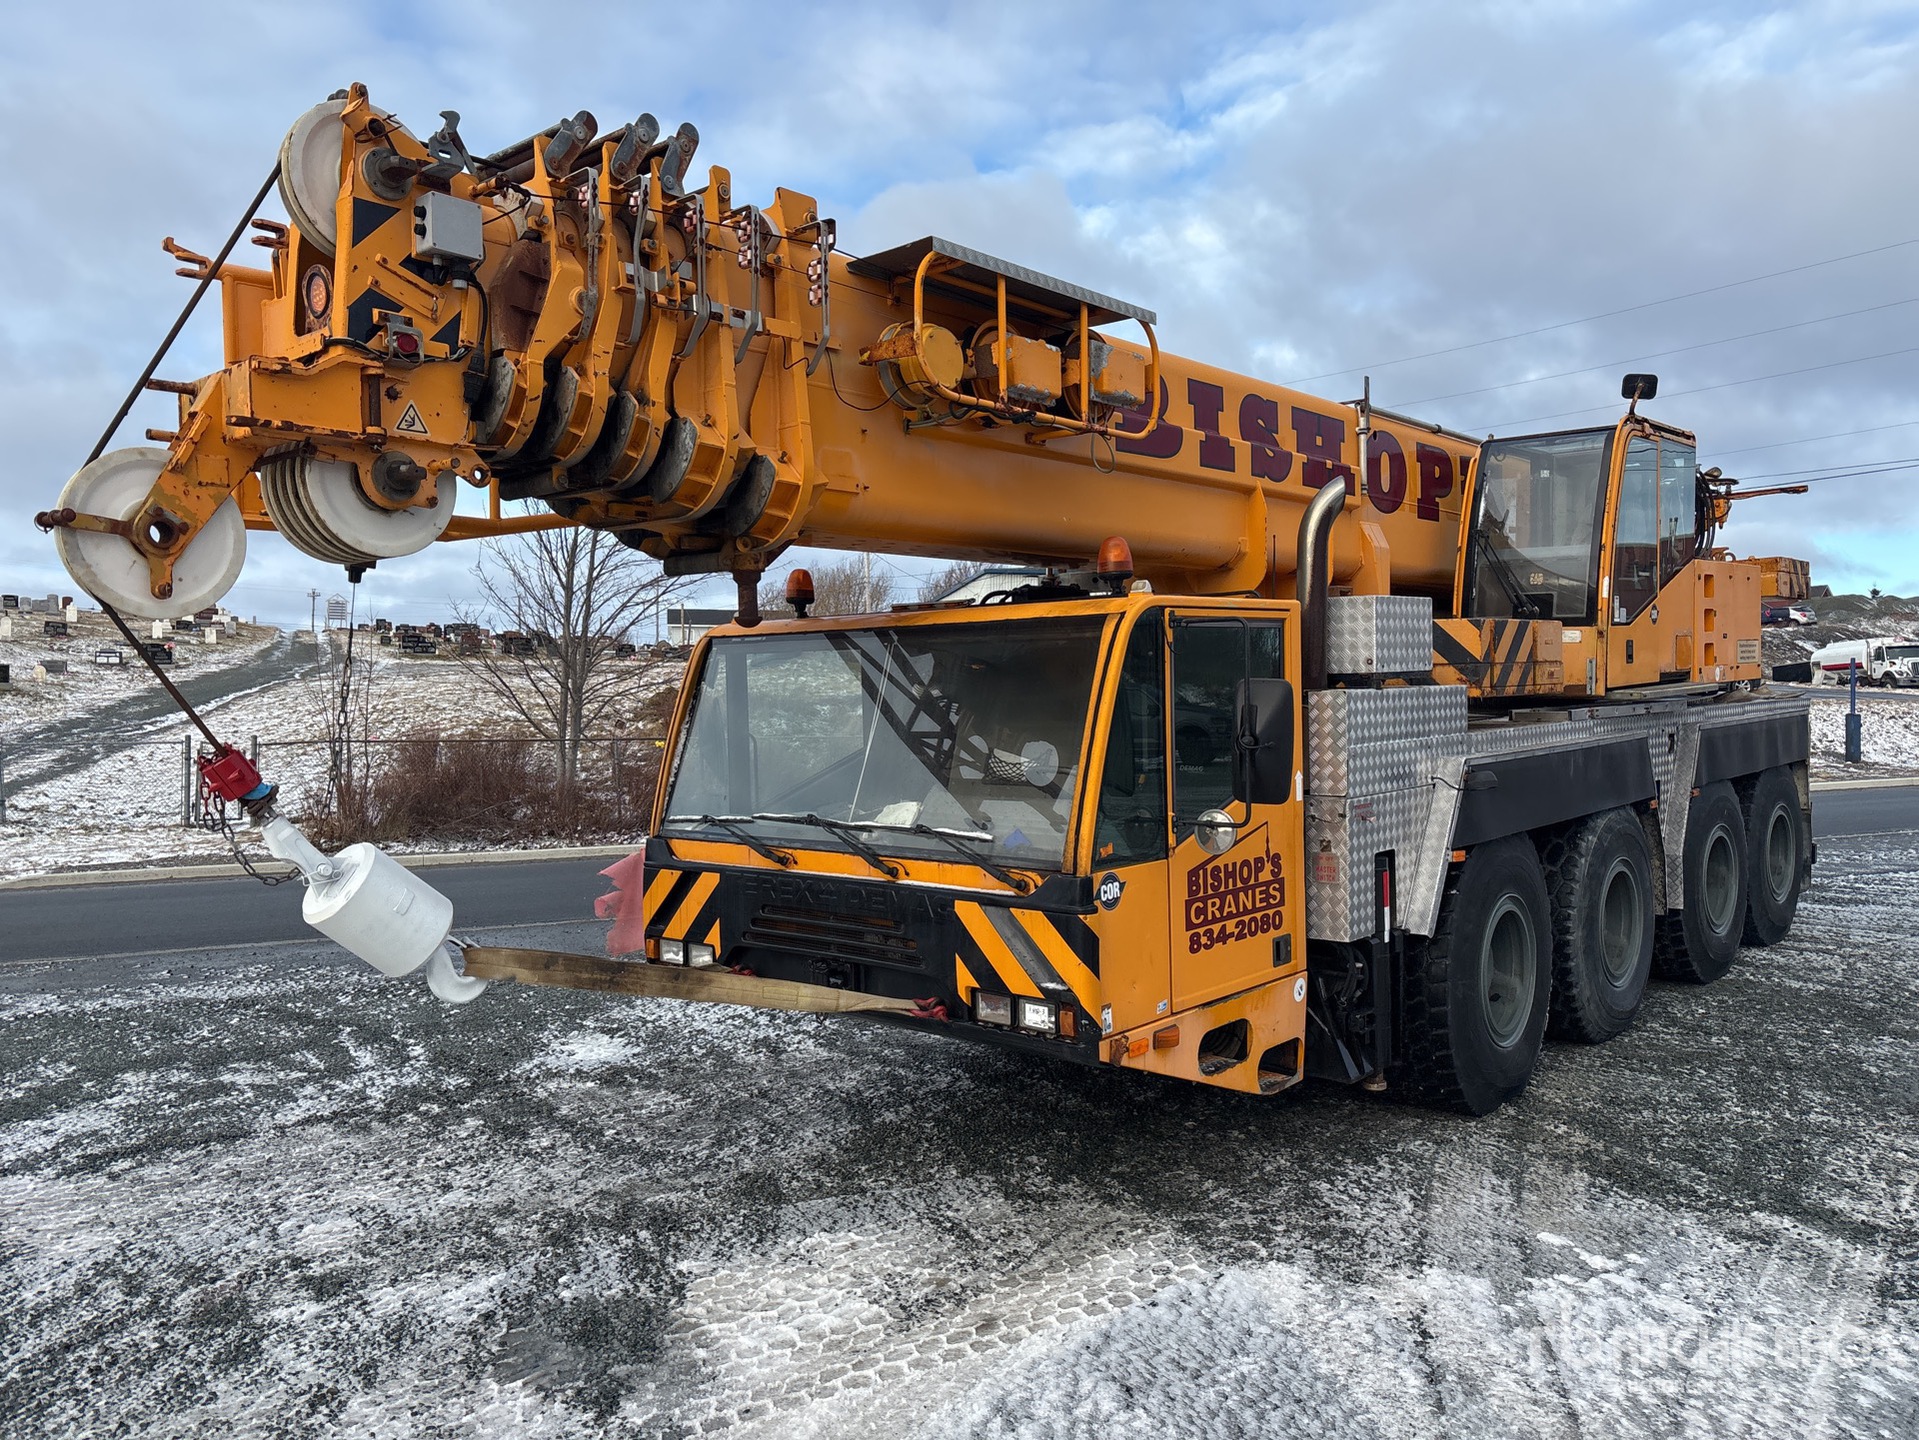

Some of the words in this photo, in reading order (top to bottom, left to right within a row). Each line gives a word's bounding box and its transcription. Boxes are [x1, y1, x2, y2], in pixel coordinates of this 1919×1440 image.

[1115, 374, 1471, 522] BISHOP
[1100, 881, 1121, 902] COR
[1187, 850, 1283, 898] BISHOP'S
[1190, 883, 1281, 924] CRANES
[1189, 909, 1283, 955] 834-2080
